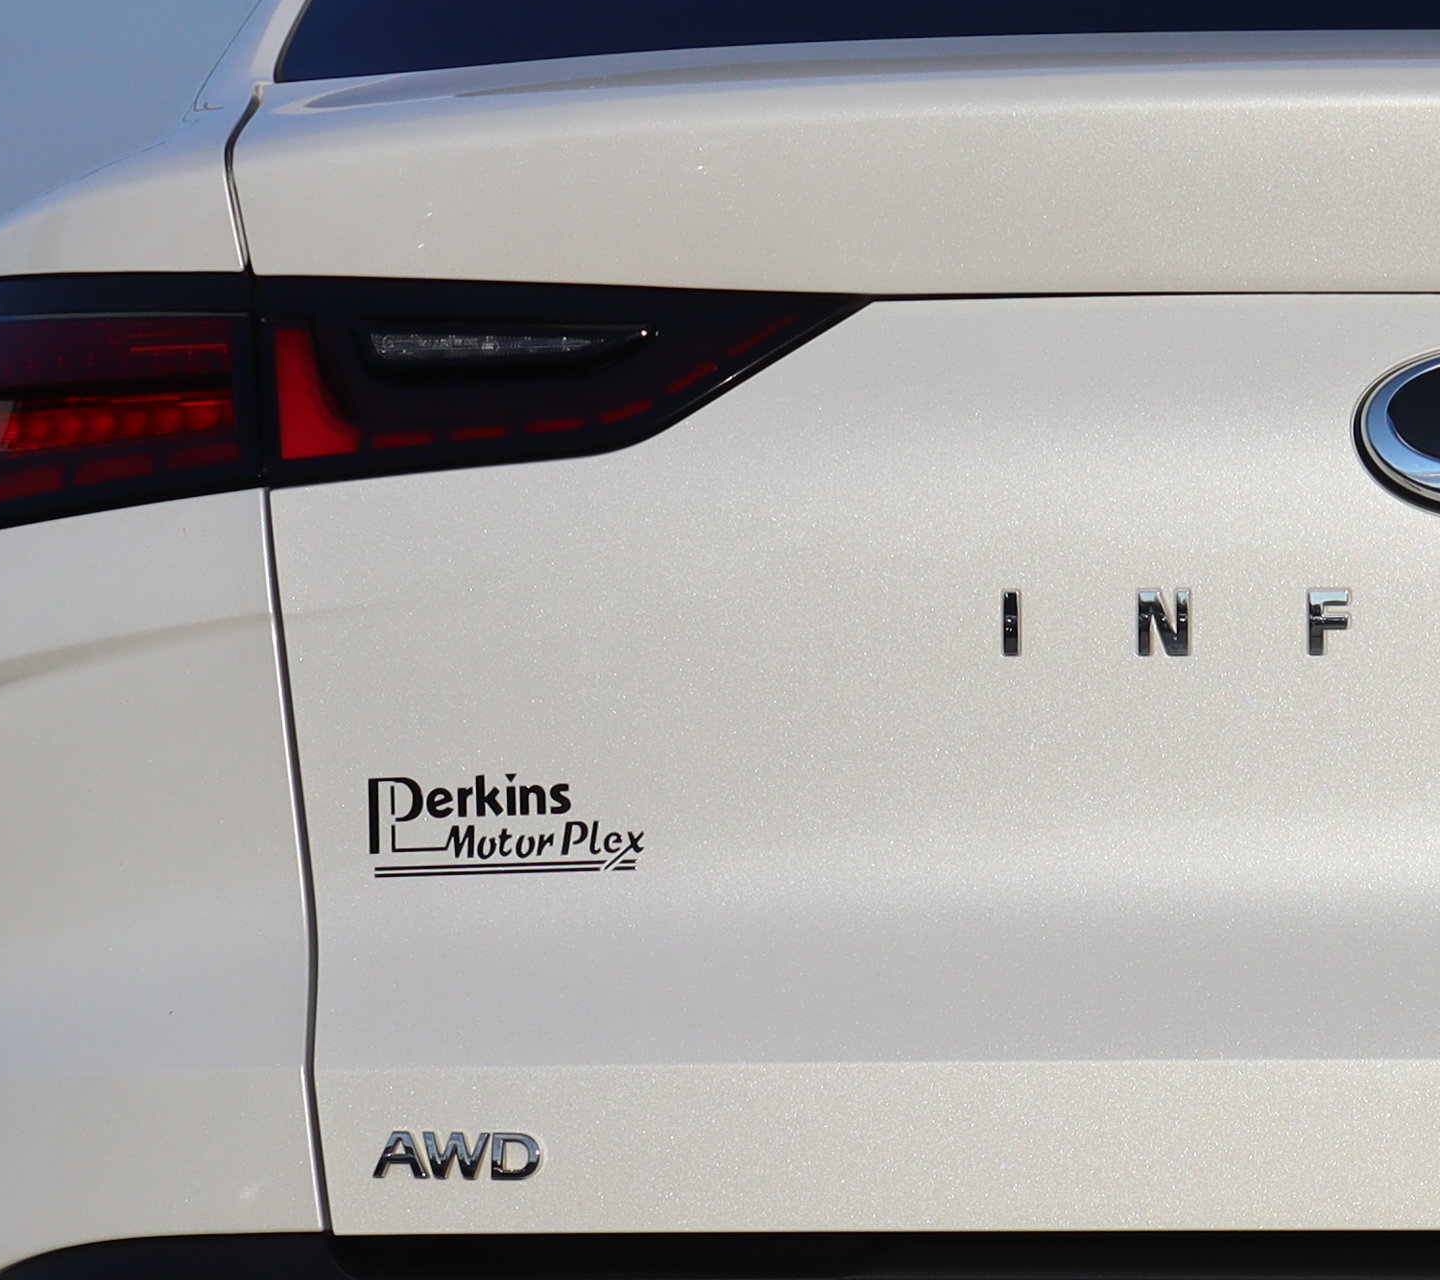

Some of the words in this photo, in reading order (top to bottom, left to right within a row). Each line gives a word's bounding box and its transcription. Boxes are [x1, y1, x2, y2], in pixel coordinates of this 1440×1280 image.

[367, 773, 572, 855] Perkins
[444, 824, 554, 860] Motor
[561, 820, 645, 871] Plex
[372, 1130, 545, 1181] AWD
